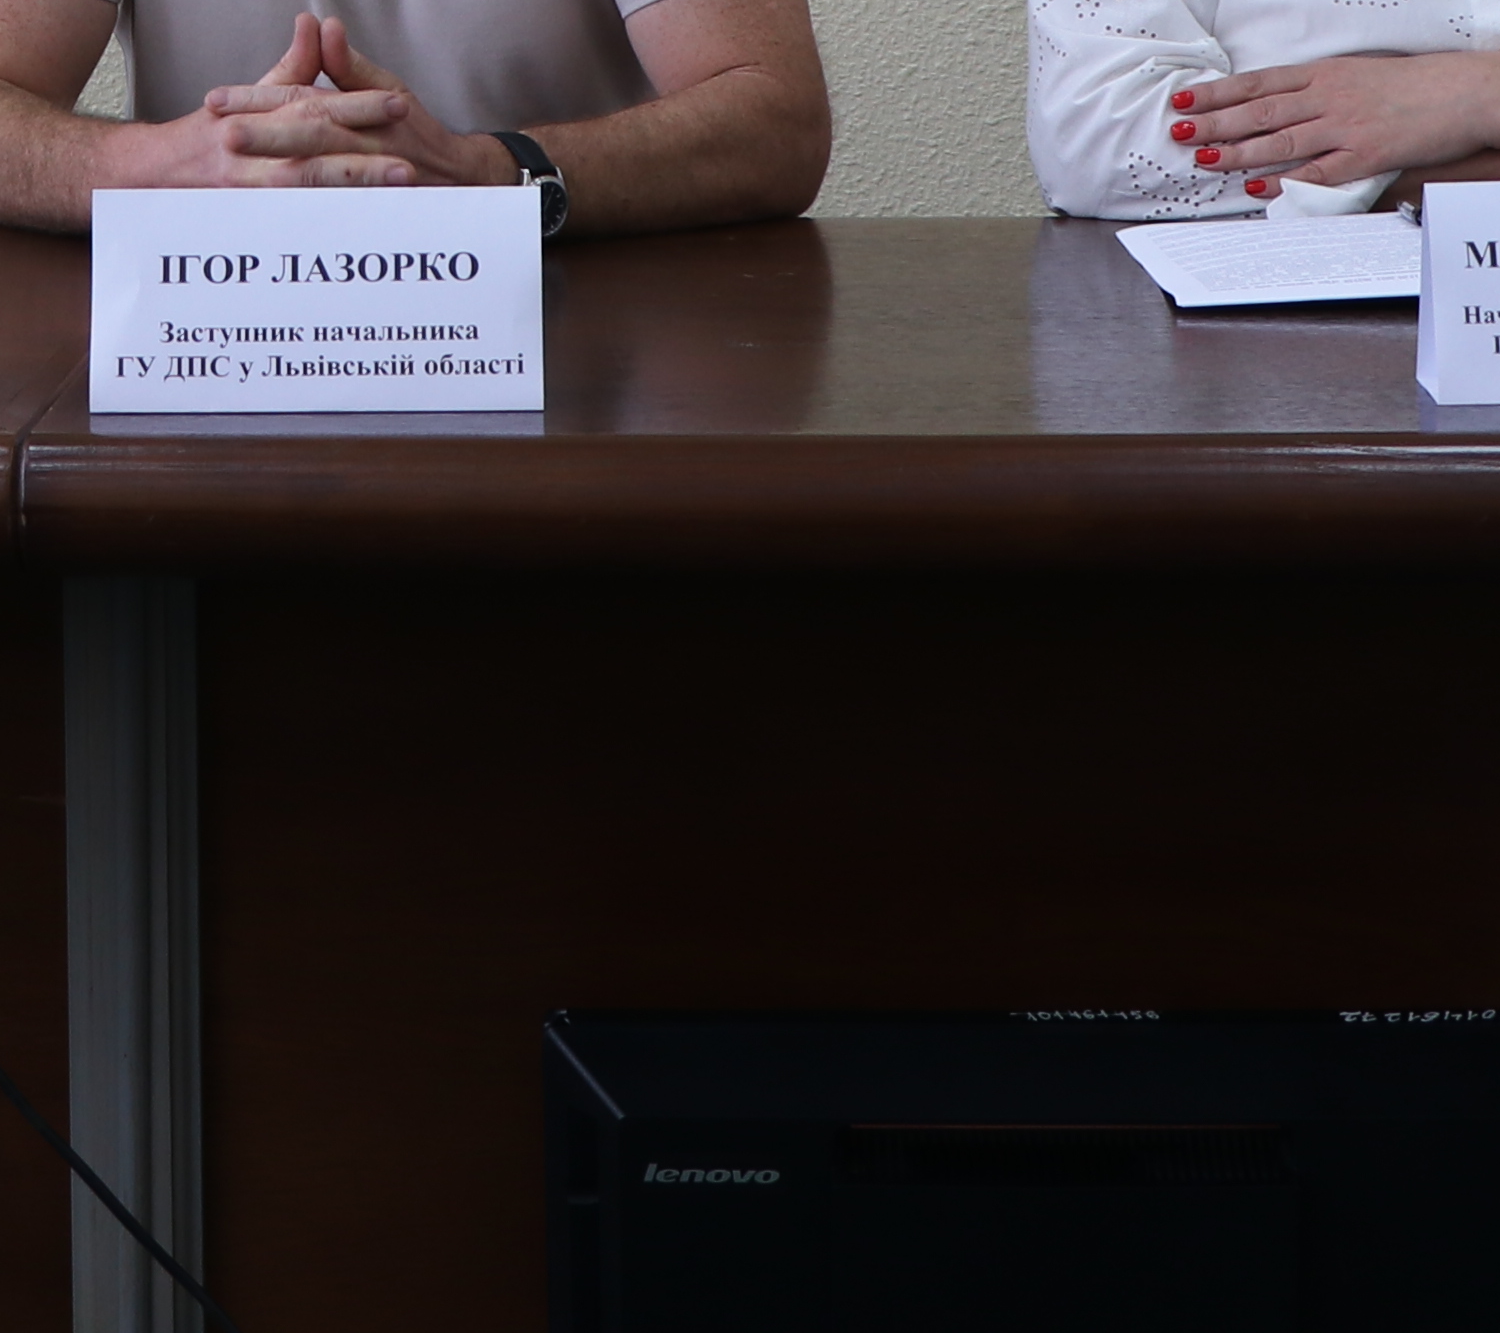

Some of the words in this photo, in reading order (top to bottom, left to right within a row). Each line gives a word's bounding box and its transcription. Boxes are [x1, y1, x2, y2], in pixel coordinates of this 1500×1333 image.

[161, 254, 260, 284] ІГОР
[270, 251, 480, 284] ЛАЗОРКО
[160, 321, 305, 349] Заступник
[313, 324, 479, 342] начальника
[117, 356, 156, 378] ГУ
[163, 355, 231, 382] ДПС
[239, 361, 254, 384] у
[261, 353, 415, 377] Львівській
[424, 352, 525, 376] області
[643, 1162, 781, 1185] lenovo
